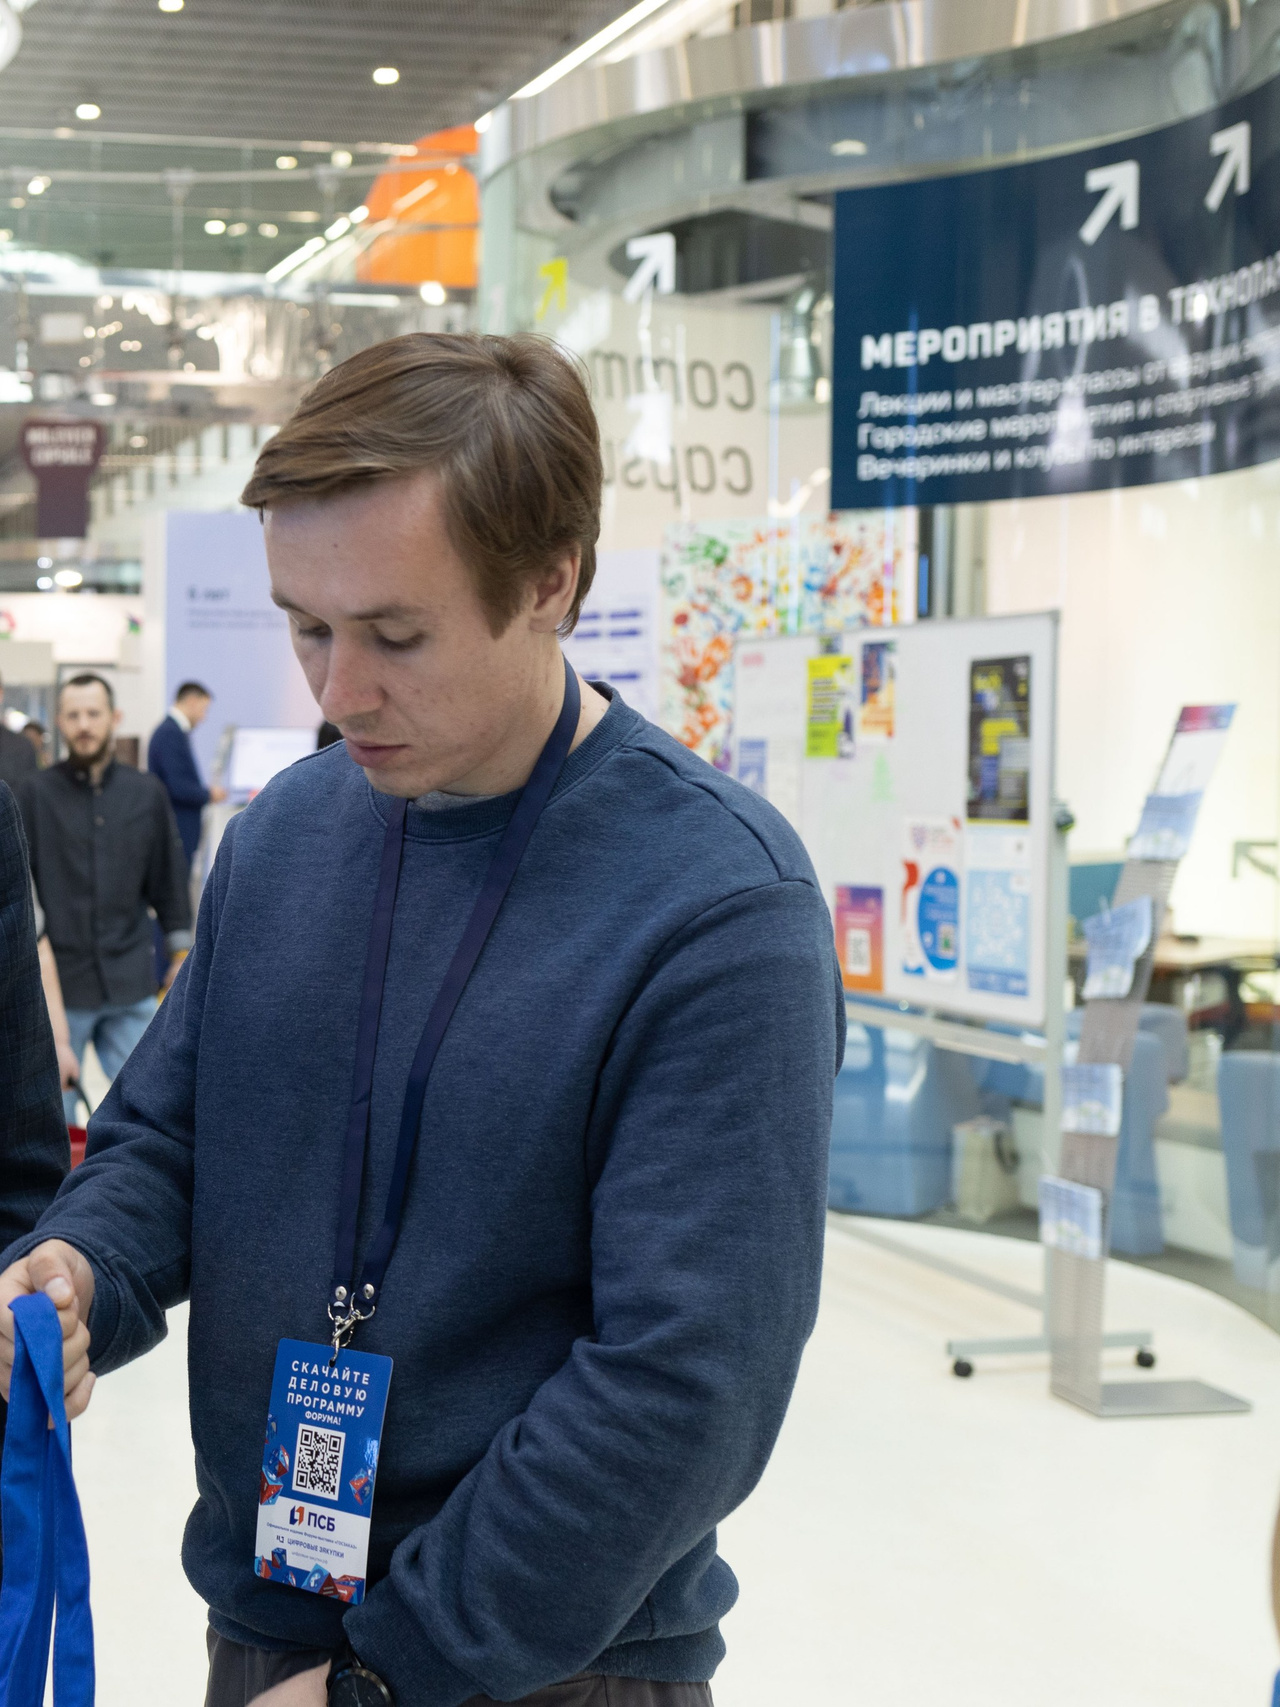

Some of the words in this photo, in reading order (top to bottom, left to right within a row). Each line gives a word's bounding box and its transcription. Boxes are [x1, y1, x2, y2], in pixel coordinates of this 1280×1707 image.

[861, 301, 1129, 370] МЕРОПРИЯТИЯ
[1138, 294, 1161, 332] В
[1168, 252, 1280, 326] ТЕХНОПА
[857, 391, 952, 419] Лекции
[954, 388, 973, 411] и
[857, 418, 988, 454] Городские
[989, 399, 1136, 442] мероятия
[857, 451, 991, 483] Вечеринки
[993, 449, 1012, 472] и
[291, 1360, 370, 1385] СКАЧАЙТЕ
[288, 1376, 367, 1401] ДЕЛОВУЮ
[286, 1392, 365, 1418] ПРОГРАММУ
[305, 1410, 342, 1426] ФОРУМА!
[307, 1512, 336, 1532] ПСБ
[287, 1538, 318, 1552] ЦИФРОВЫЕ
